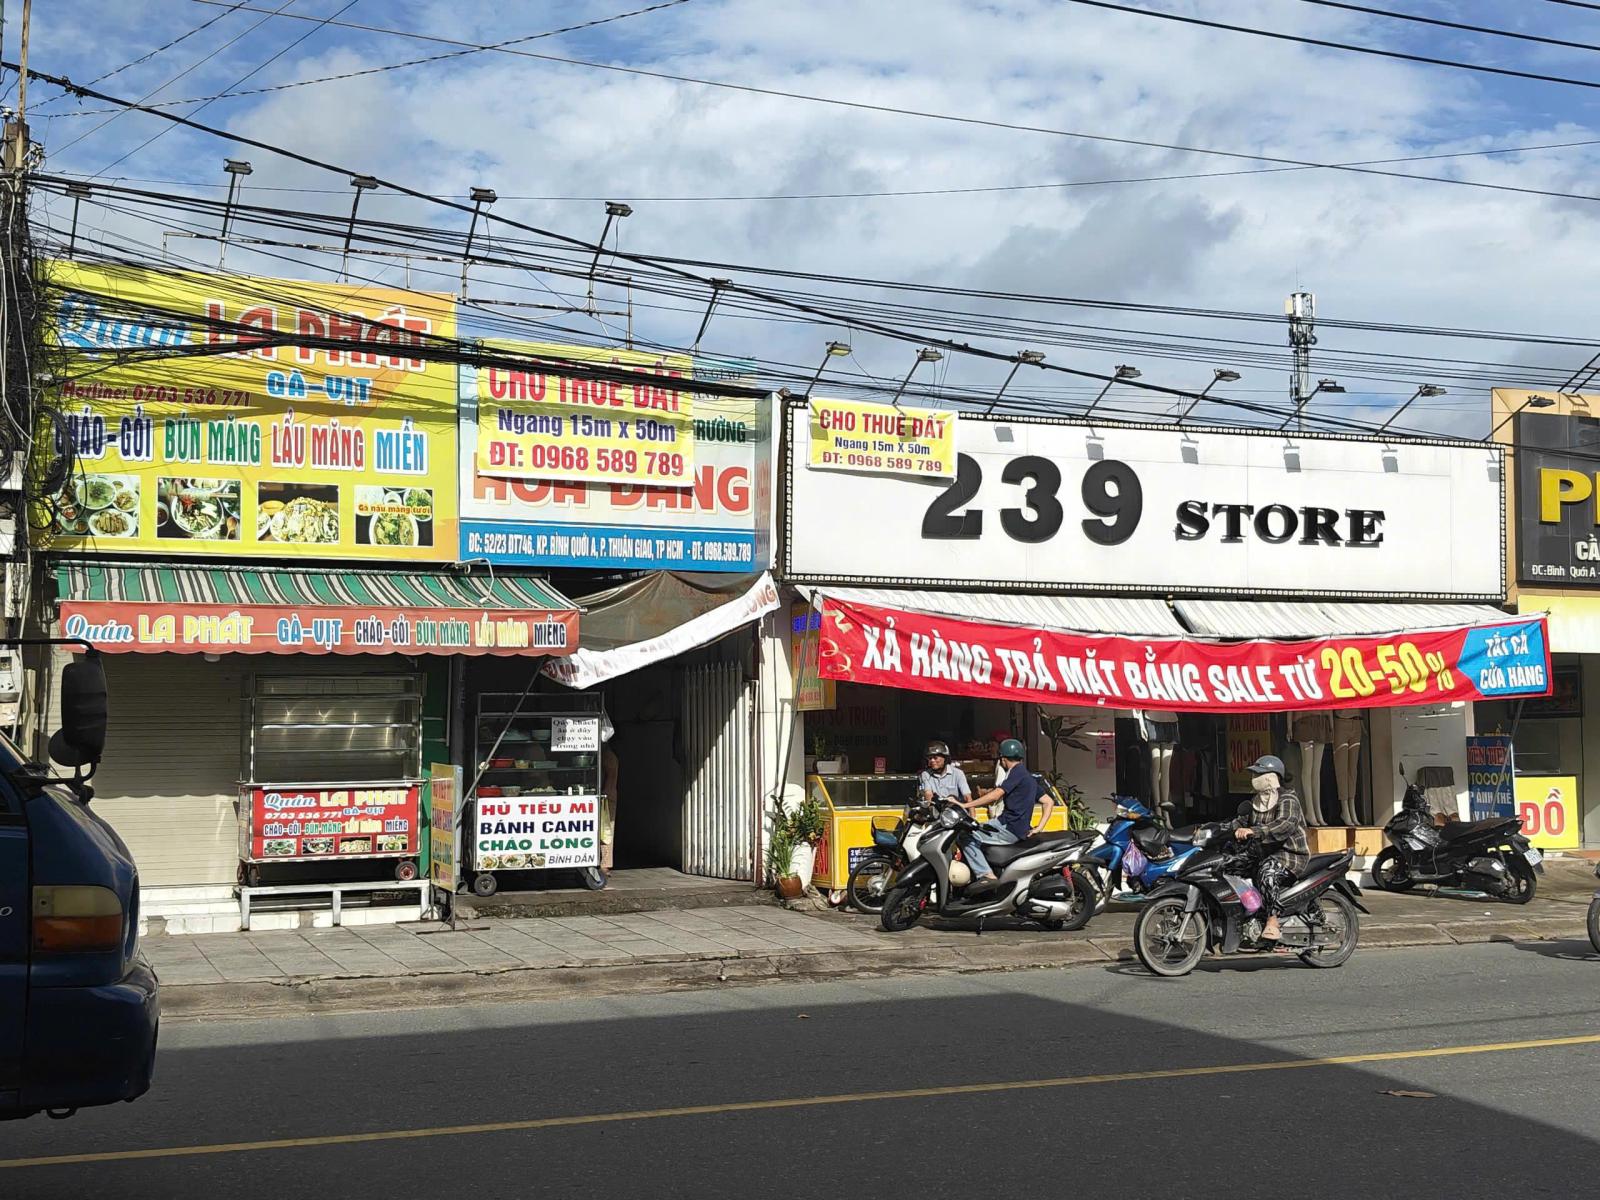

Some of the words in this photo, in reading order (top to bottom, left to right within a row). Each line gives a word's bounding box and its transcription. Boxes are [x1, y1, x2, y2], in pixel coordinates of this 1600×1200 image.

[132, 385, 178, 402] 0703
[183, 388, 217, 404] 536
[222, 391, 251, 406] 771
[498, 409, 563, 436] Ngang
[569, 414, 612, 437] 15m
[636, 419, 676, 441] 50m
[819, 409, 856, 431] CHO
[862, 412, 906, 437] THUÊ
[911, 413, 946, 439] ĐẤT
[165, 411, 201, 460] BÚN
[208, 416, 260, 464] MĂNG
[311, 420, 364, 468] MĂNG
[835, 436, 869, 451] Ngang
[872, 441, 894, 453] 15m
[908, 443, 930, 455] 50m
[490, 441, 524, 467] ĐT:
[532, 444, 588, 470] 0968
[596, 448, 637, 473] 589
[644, 451, 684, 477] 789
[823, 451, 843, 464] ĐT:
[848, 454, 882, 467] 0968
[887, 457, 912, 469] 589
[917, 459, 942, 472] 789
[921, 451, 1144, 547] 239
[1174, 499, 1387, 549] STORE
[1539, 468, 1600, 525] P
[666, 540, 684, 559] HCM
[1589, 566, 1596, 577] A
[66, 615, 134, 645] Quán
[138, 614, 175, 644] LA
[277, 613, 343, 650] GÀ-VỊT
[416, 616, 437, 646] BÚN
[440, 617, 470, 646] MĂNG
[862, 616, 903, 672] XẢ
[910, 629, 992, 684] HÀNG
[994, 637, 1058, 692] TRẢ
[1056, 648, 1123, 705] MẶT
[1123, 645, 1209, 703] BẰNG
[1207, 663, 1285, 703] SALE
[1279, 654, 1323, 701] TỪ
[1320, 641, 1456, 699] 20-50%
[1480, 661, 1506, 690] CỬA
[1507, 661, 1545, 687] HÀNG
[518, 800, 562, 815] TIẾU
[569, 799, 594, 814] MÌ
[1516, 788, 1565, 836] ĐỒ
[480, 819, 535, 835] BÁNH
[542, 820, 594, 833] CANH
[479, 836, 533, 851] CHÁO
[540, 835, 594, 850] LÒNG
[548, 854, 572, 864] BÌNH
